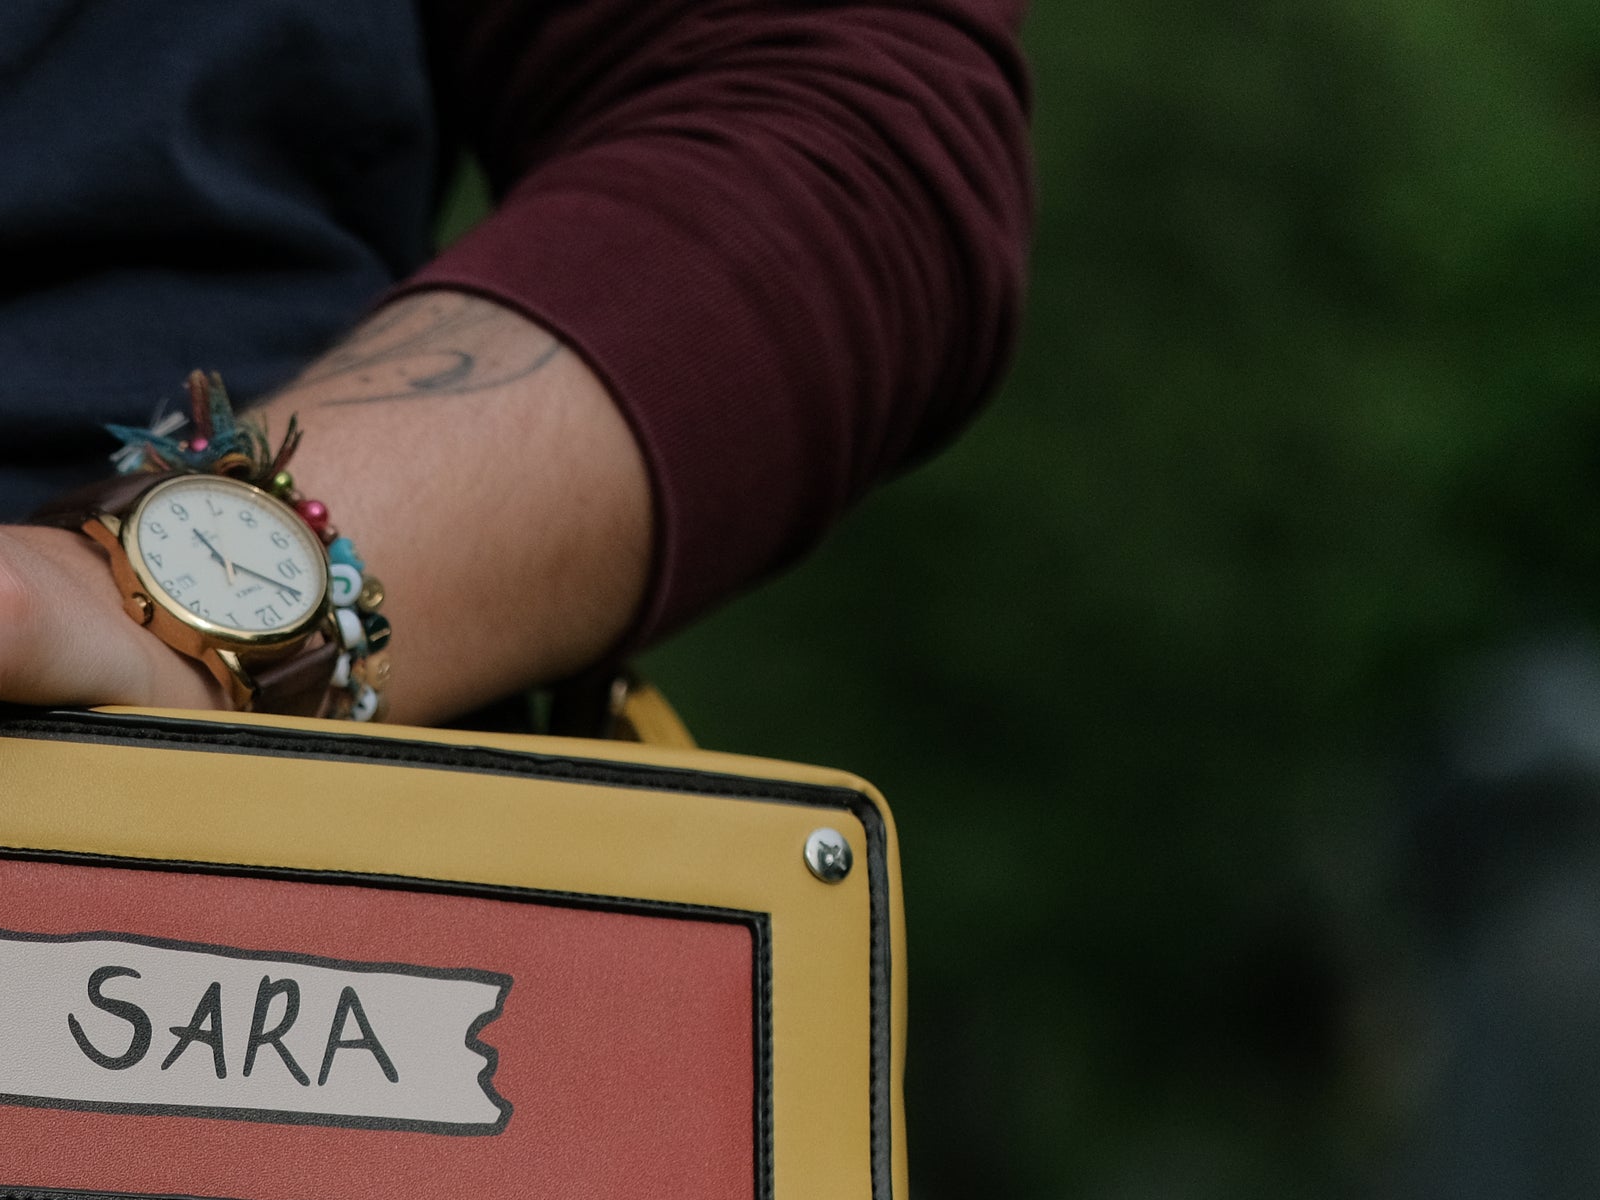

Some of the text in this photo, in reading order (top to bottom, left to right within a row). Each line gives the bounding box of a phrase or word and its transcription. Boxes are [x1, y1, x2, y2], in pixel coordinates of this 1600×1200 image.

[170, 502, 190, 522] 6
[205, 499, 224, 517] 7
[238, 509, 258, 529] 8
[149, 521, 169, 540] 5
[269, 530, 290, 550] 9
[147, 551, 163, 569] 4
[277, 557, 303, 580] 10
[162, 579, 182, 598] 3
[189, 599, 211, 618] 2
[255, 604, 283, 627] 12
[68, 965, 399, 1087] SARA
